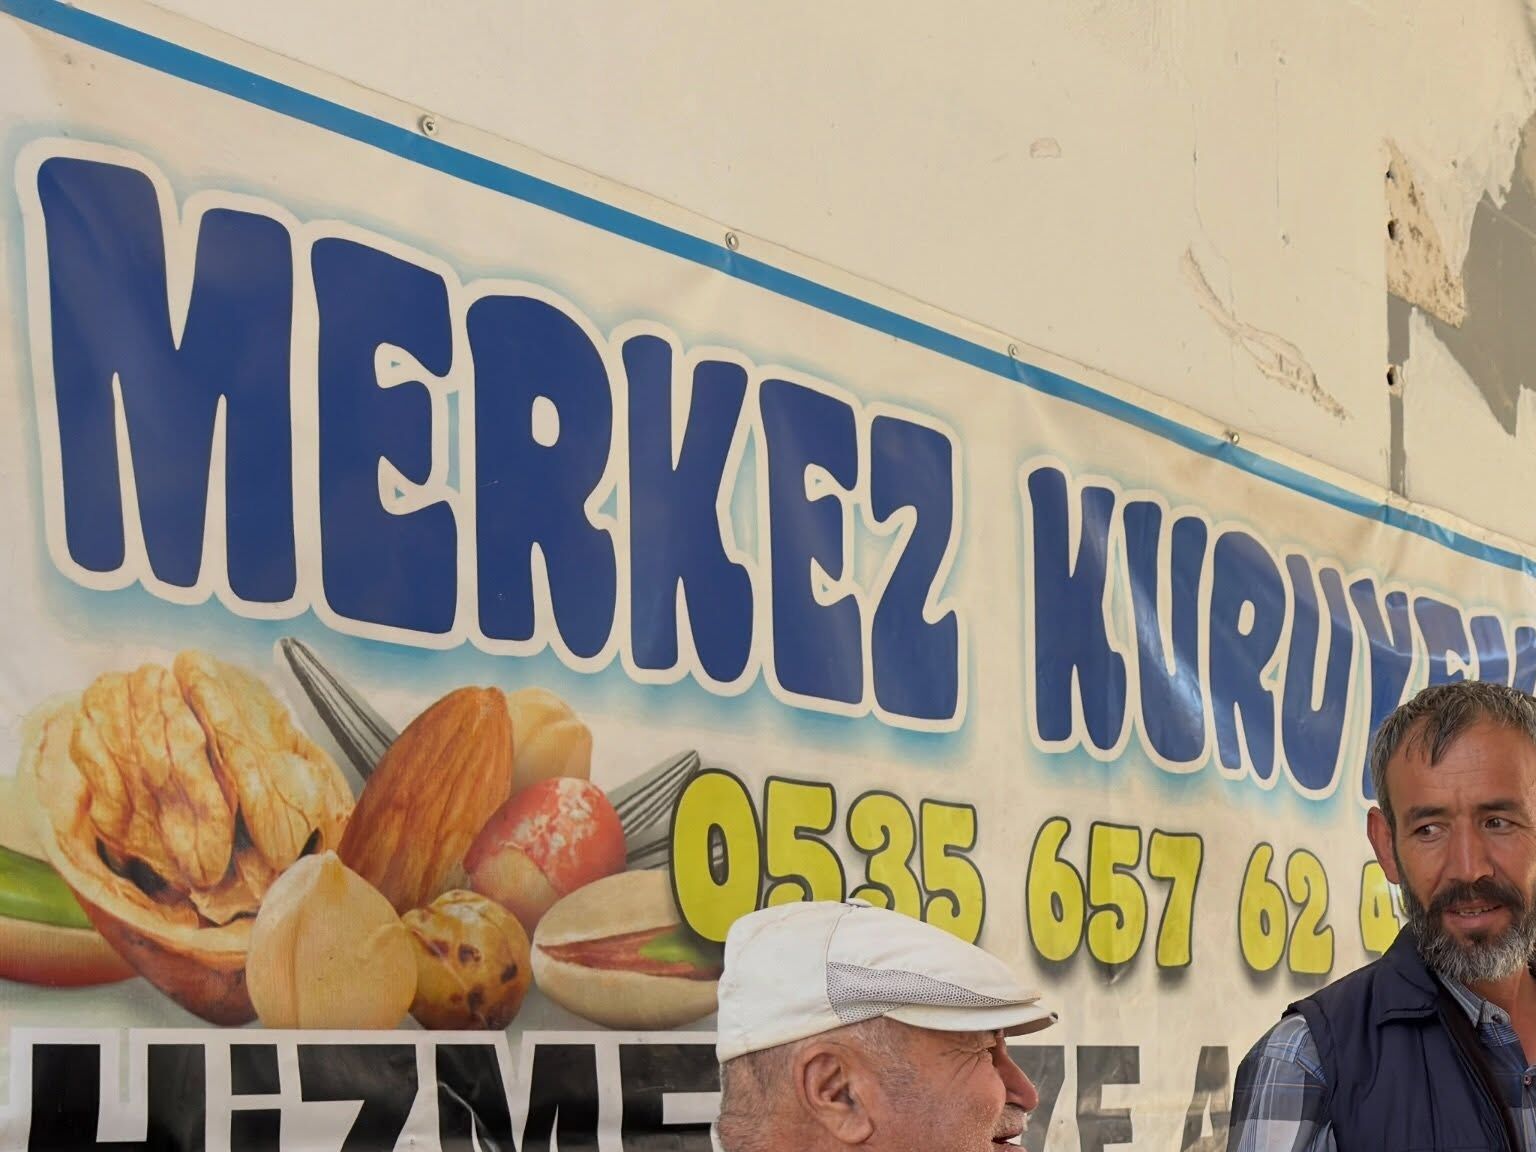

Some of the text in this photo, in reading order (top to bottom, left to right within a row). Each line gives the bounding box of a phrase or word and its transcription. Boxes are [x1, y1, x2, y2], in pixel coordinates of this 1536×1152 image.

[37, 155, 959, 720] MERKEZ
[671, 767, 1409, 975] 0535 657 62 4
